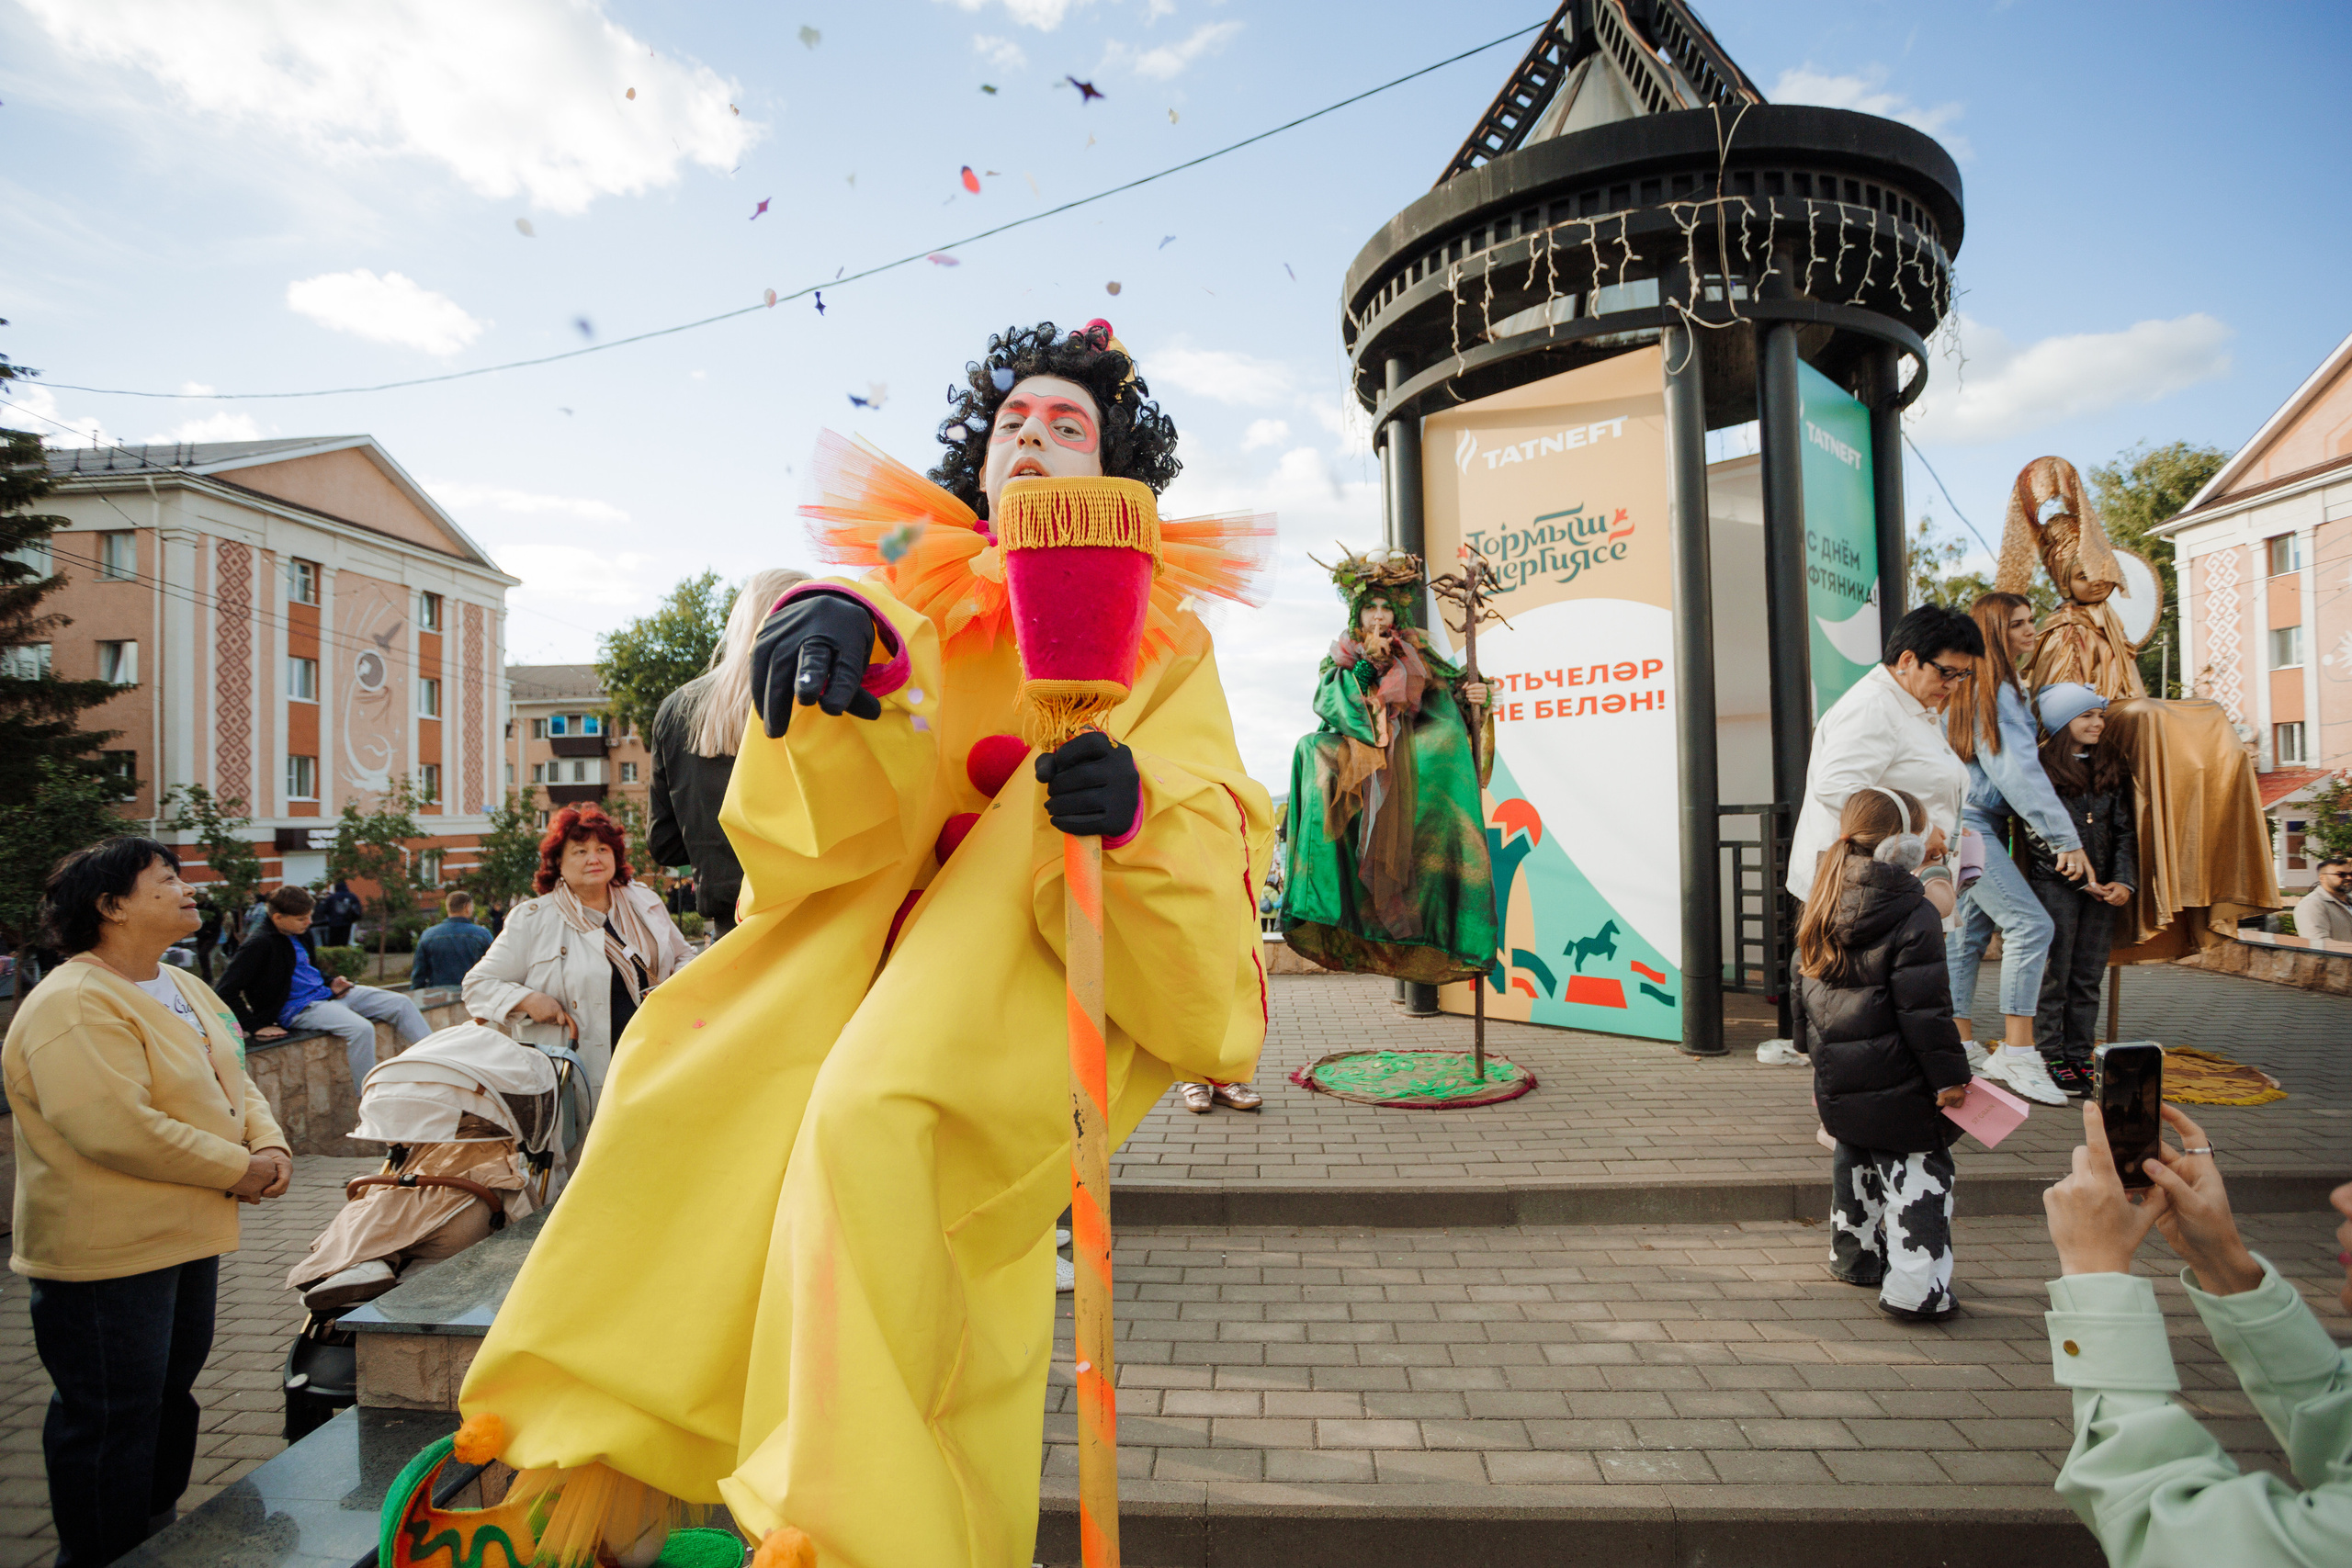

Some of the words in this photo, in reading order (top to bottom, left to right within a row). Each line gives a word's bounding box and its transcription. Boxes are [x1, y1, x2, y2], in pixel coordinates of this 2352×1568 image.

[1482, 415, 1629, 469] TATNEFT
[1805, 421, 1861, 469] TATNEFT
[1481, 541, 1628, 590] нергиясе
[1806, 530, 1817, 551] С
[1821, 537, 1860, 571] ДНЁМ
[1807, 564, 1878, 607] ФТЯНИКА!
[1534, 689, 1666, 719] БЕЛӘН!
